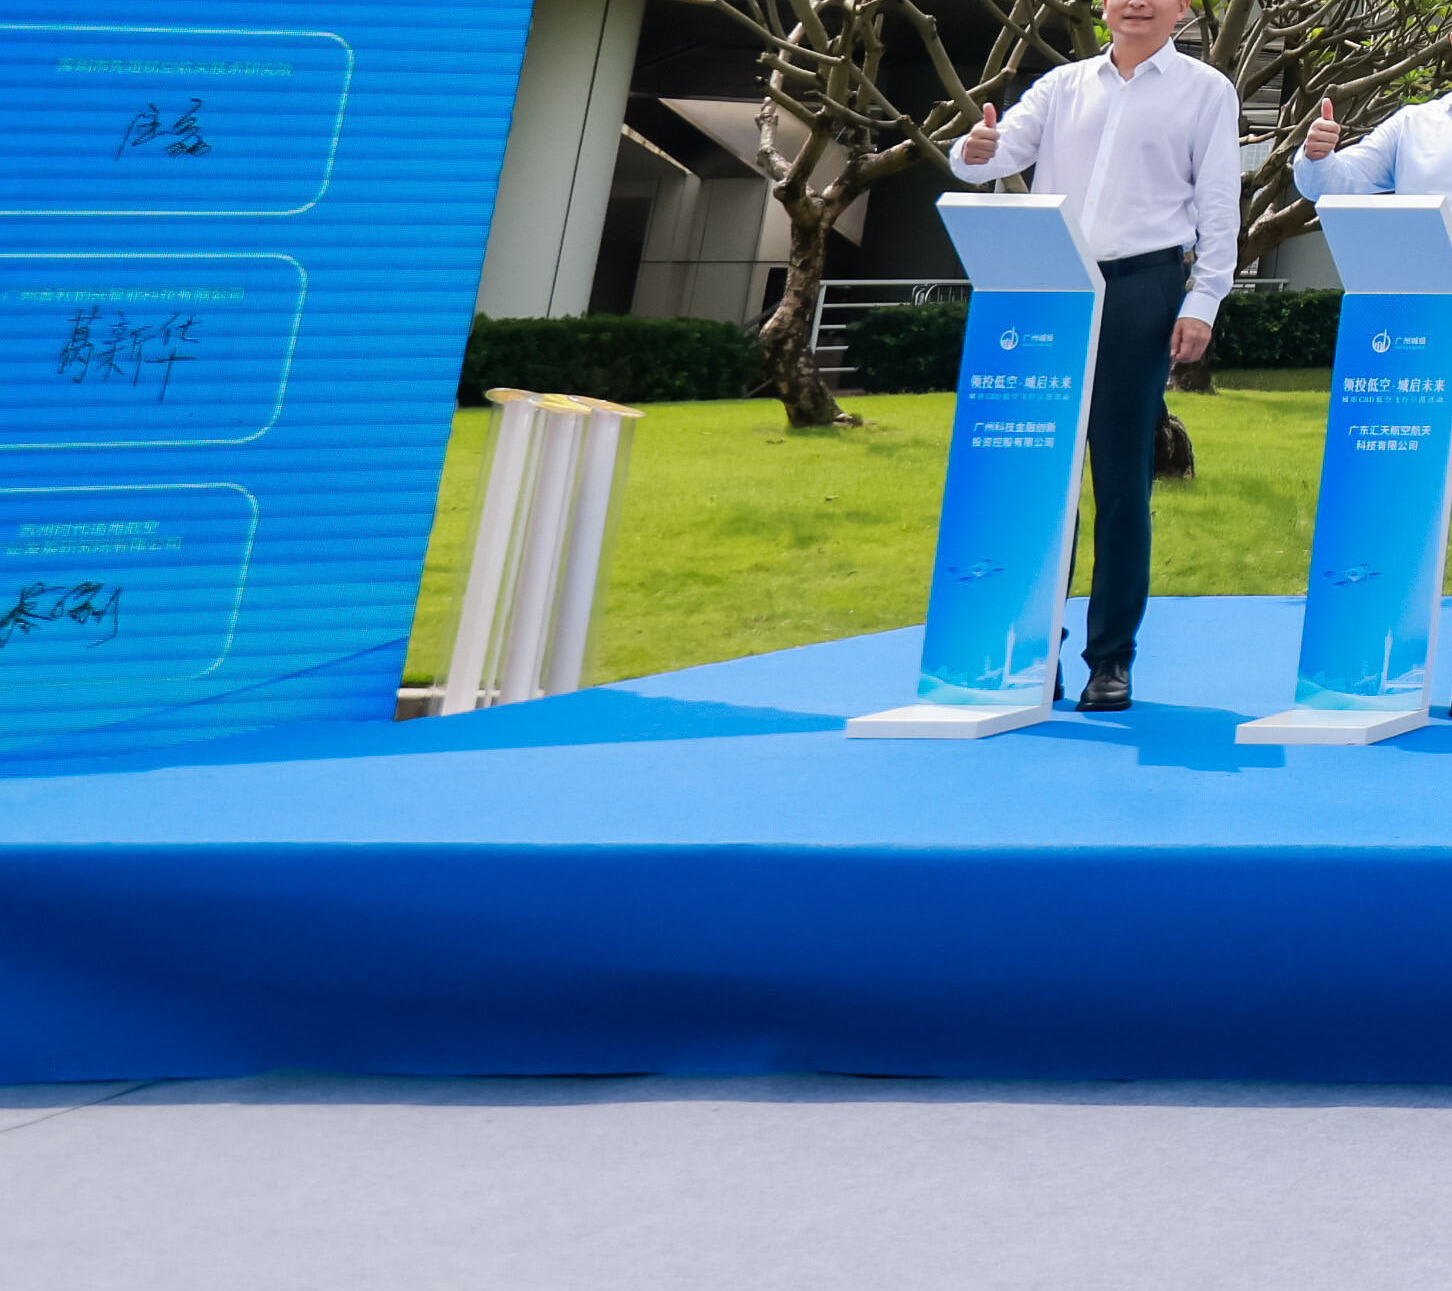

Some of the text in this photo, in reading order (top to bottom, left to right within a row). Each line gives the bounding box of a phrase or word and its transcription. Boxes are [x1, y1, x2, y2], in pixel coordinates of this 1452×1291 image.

[1348, 425, 1432, 436] 广东汇天航空航天
[1356, 440, 1419, 451] 科技有限公司
